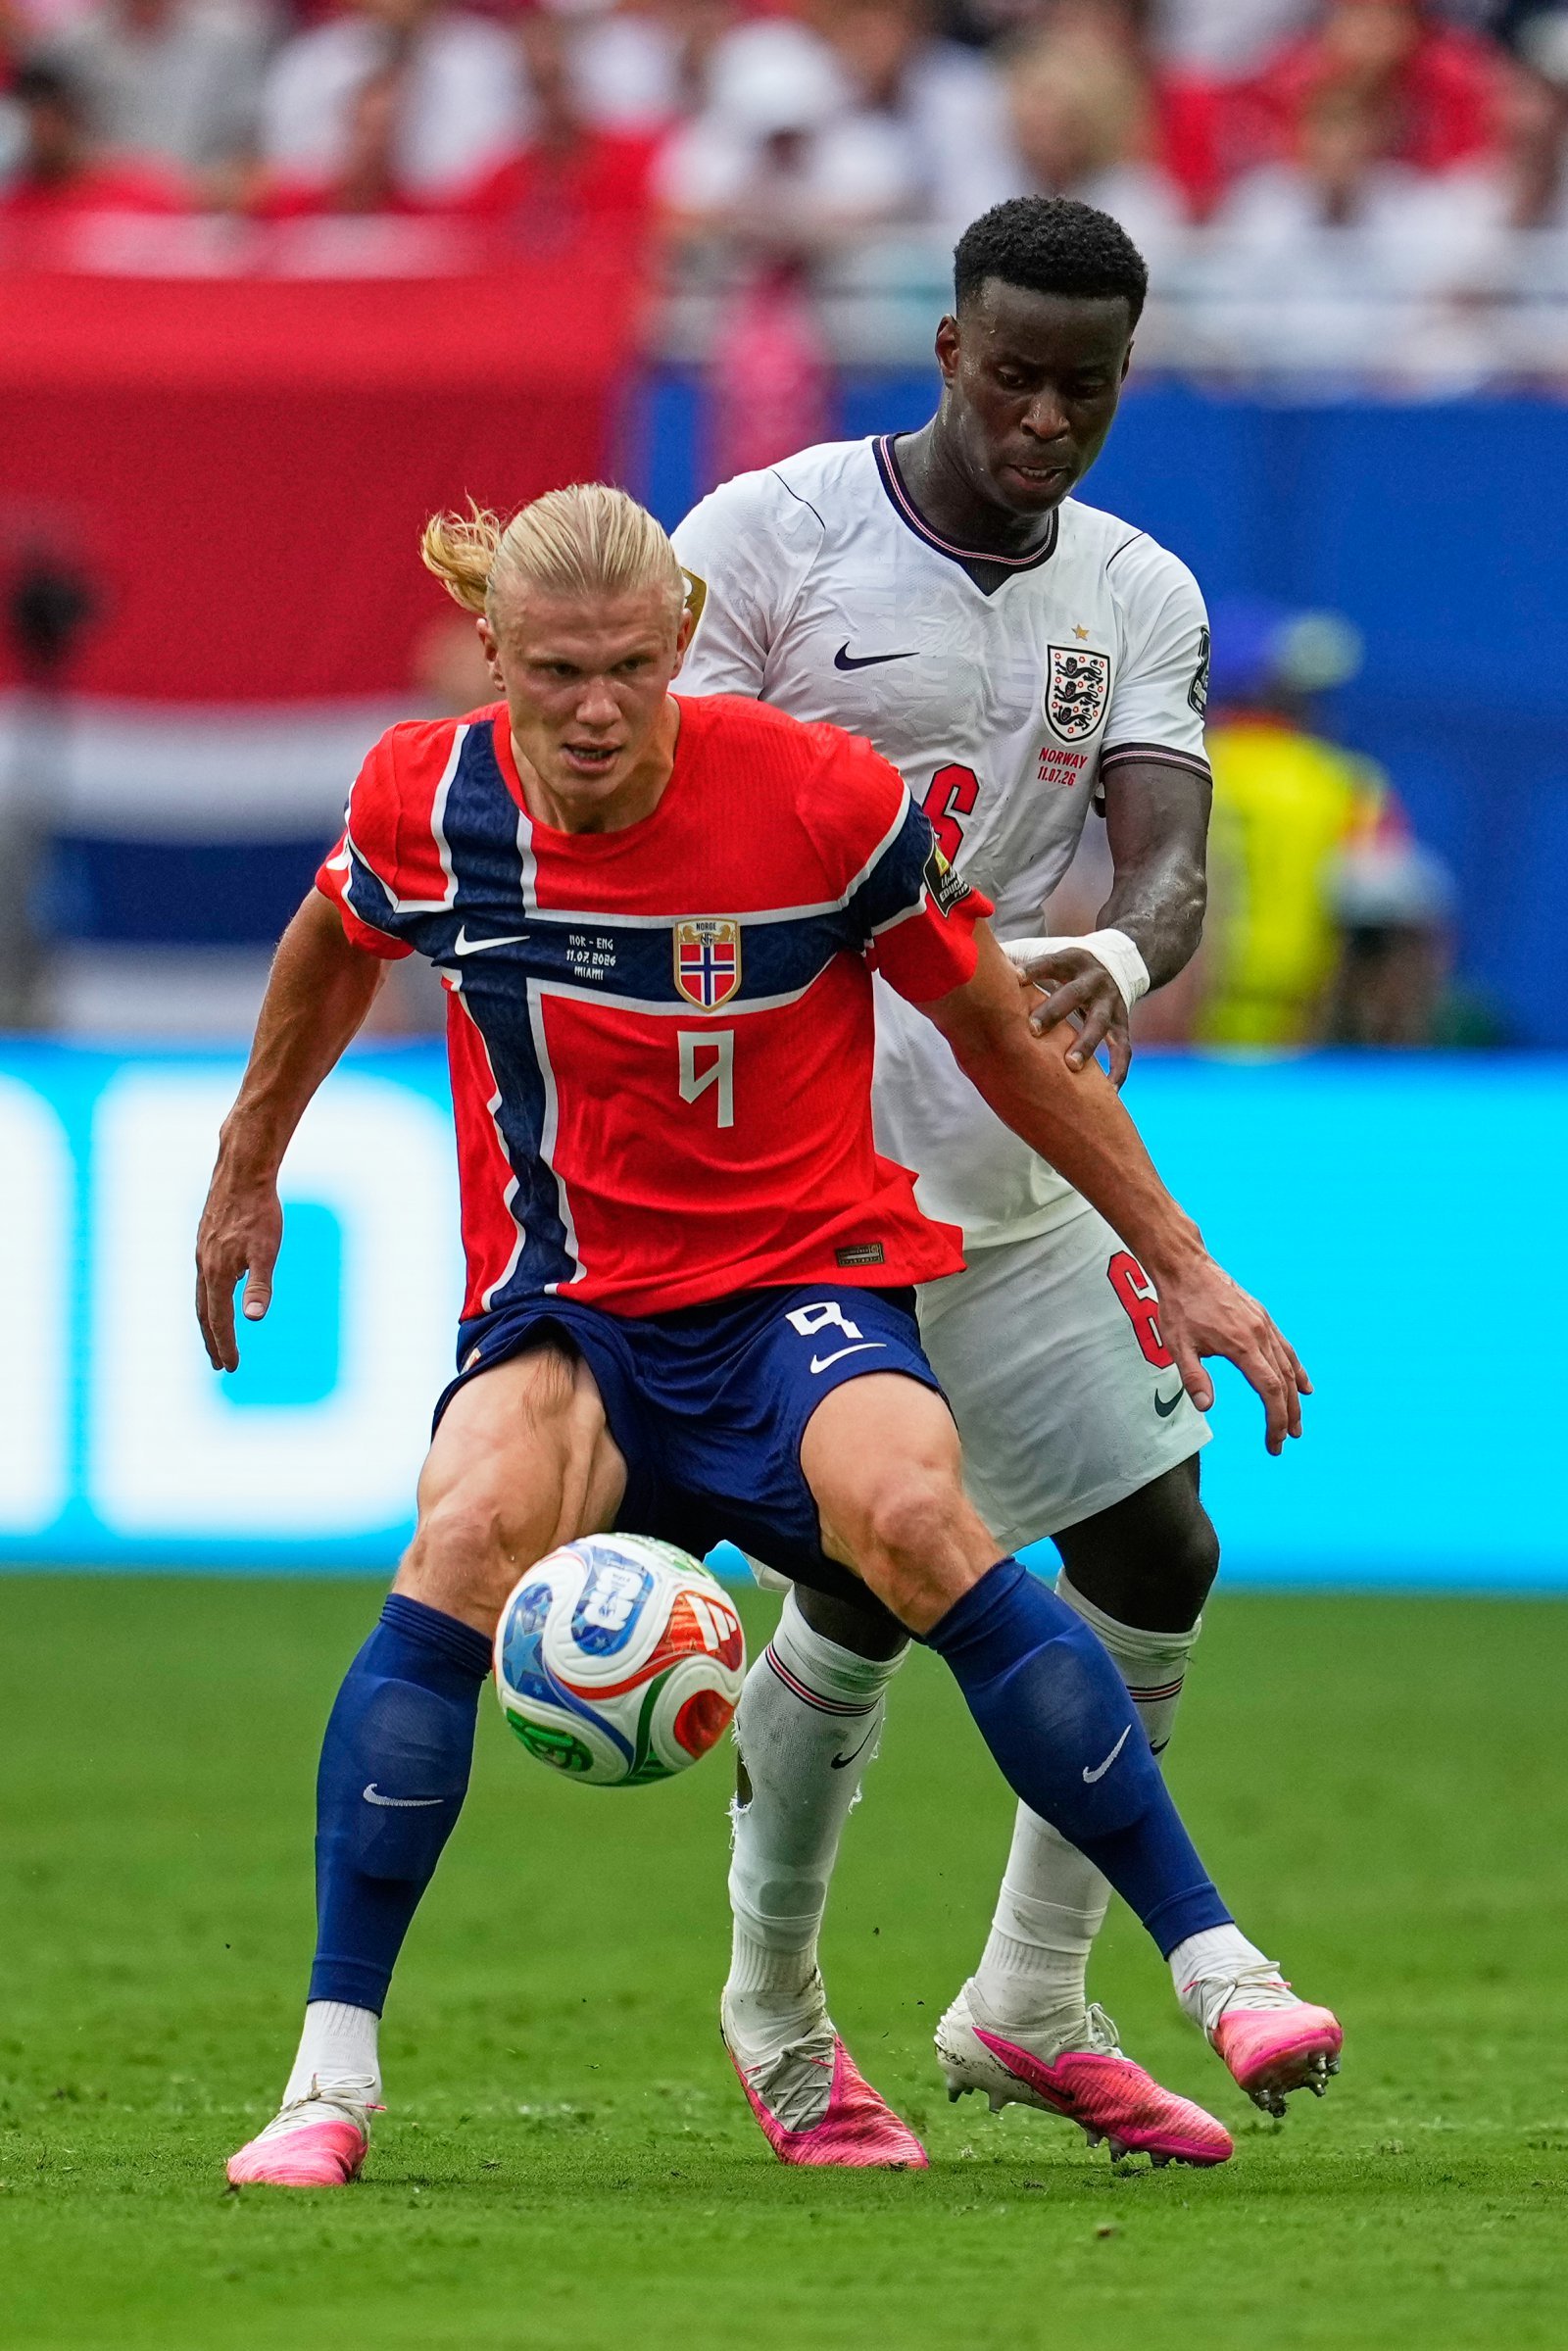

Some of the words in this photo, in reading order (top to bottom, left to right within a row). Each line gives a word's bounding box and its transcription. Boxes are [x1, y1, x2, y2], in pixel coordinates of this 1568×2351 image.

[1039, 747, 1088, 769] NORWAY
[1037, 765, 1076, 786] 11.07.26
[696, 922, 716, 931] NORGE
[569, 934, 586, 947] NOR
[596, 937, 613, 951] ENG
[574, 965, 604, 981] MIAMI
[677, 1029, 734, 1128] 9
[1107, 1250, 1175, 1369] 6
[786, 1301, 862, 1340] 9
